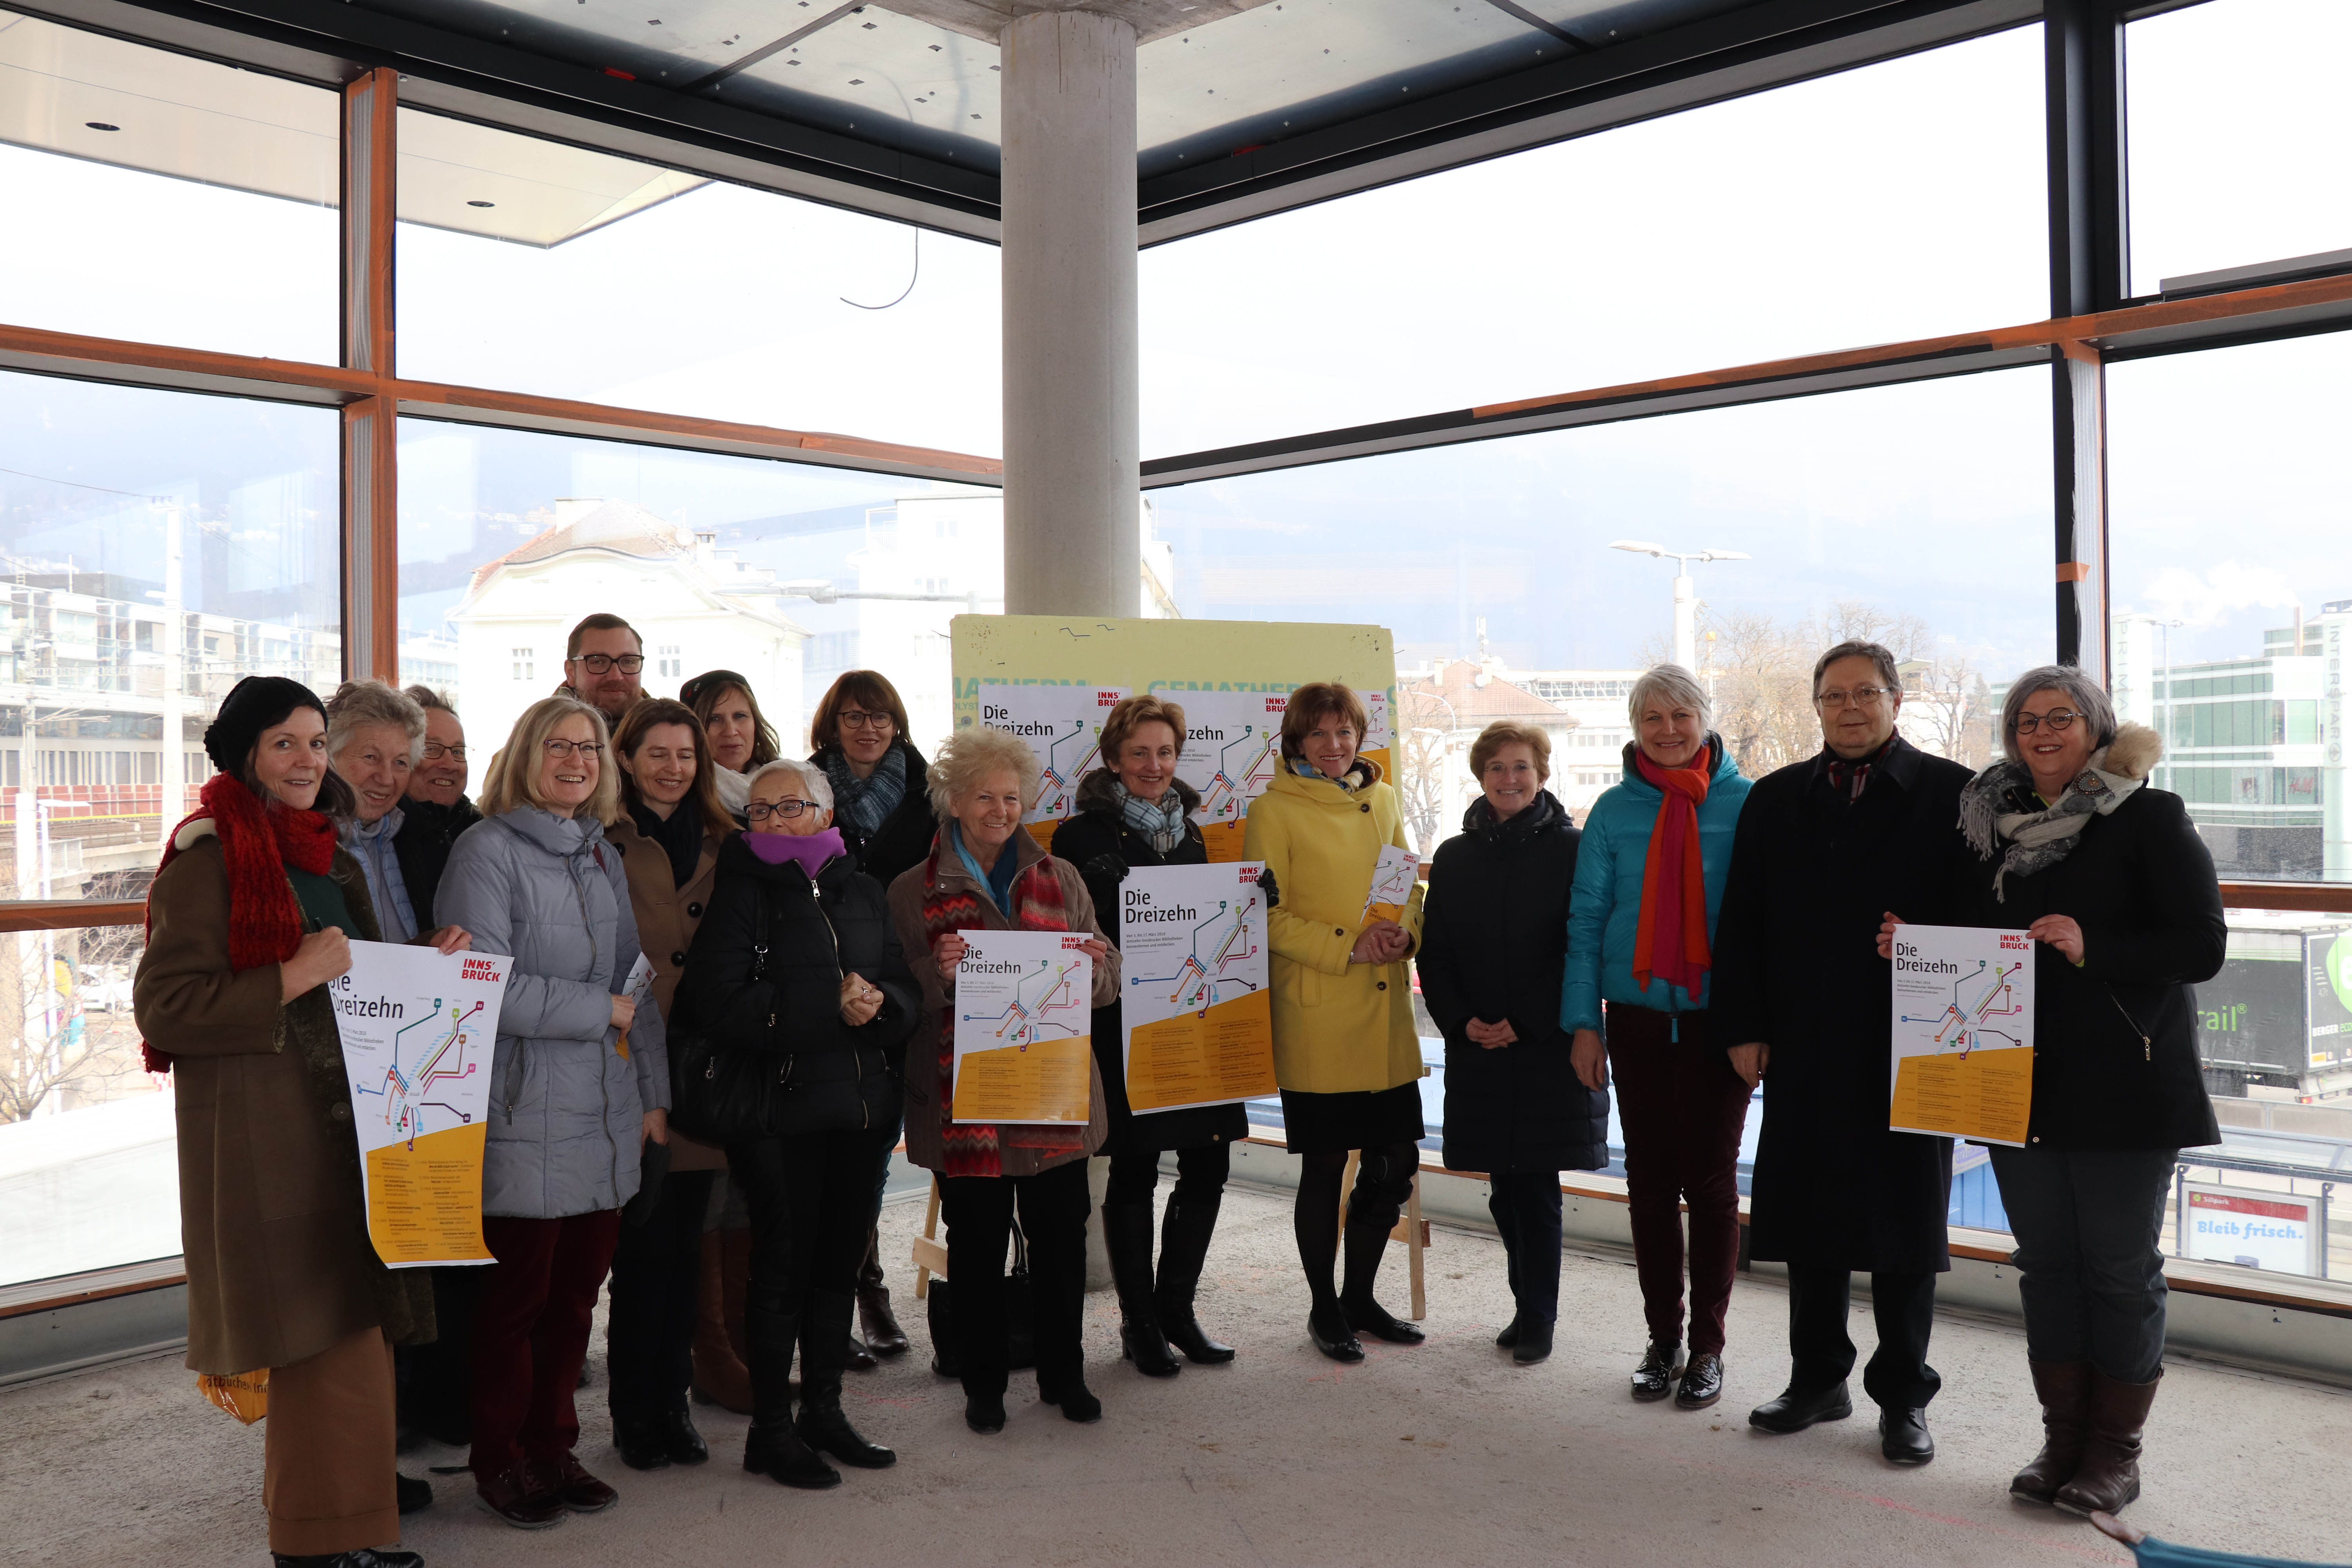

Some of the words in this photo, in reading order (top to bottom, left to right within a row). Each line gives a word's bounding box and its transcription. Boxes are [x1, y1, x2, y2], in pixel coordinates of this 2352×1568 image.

[2330, 625, 2340, 739] INTERSPAR
[984, 705, 1008, 719] Die
[1185, 726, 1223, 740] zehn
[1126, 889, 1151, 905] Die
[1126, 905, 1196, 924] Dreizehn
[1369, 913, 1390, 922] Dreizeh
[1897, 942, 1917, 956] Die
[2000, 942, 2029, 950] BRUCK
[463, 958, 495, 970] INNS'
[961, 960, 1021, 974] Dreizehn
[1897, 958, 1958, 974] Dreizehn
[462, 969, 501, 982] BRUCK
[332, 992, 403, 1018] Dreizehn
[2312, 1024, 2339, 1037] BERGER
[2203, 1196, 2230, 1205] Sillpark
[2197, 1220, 2240, 1235] Bleib
[2243, 1223, 2303, 1240] frisch.
